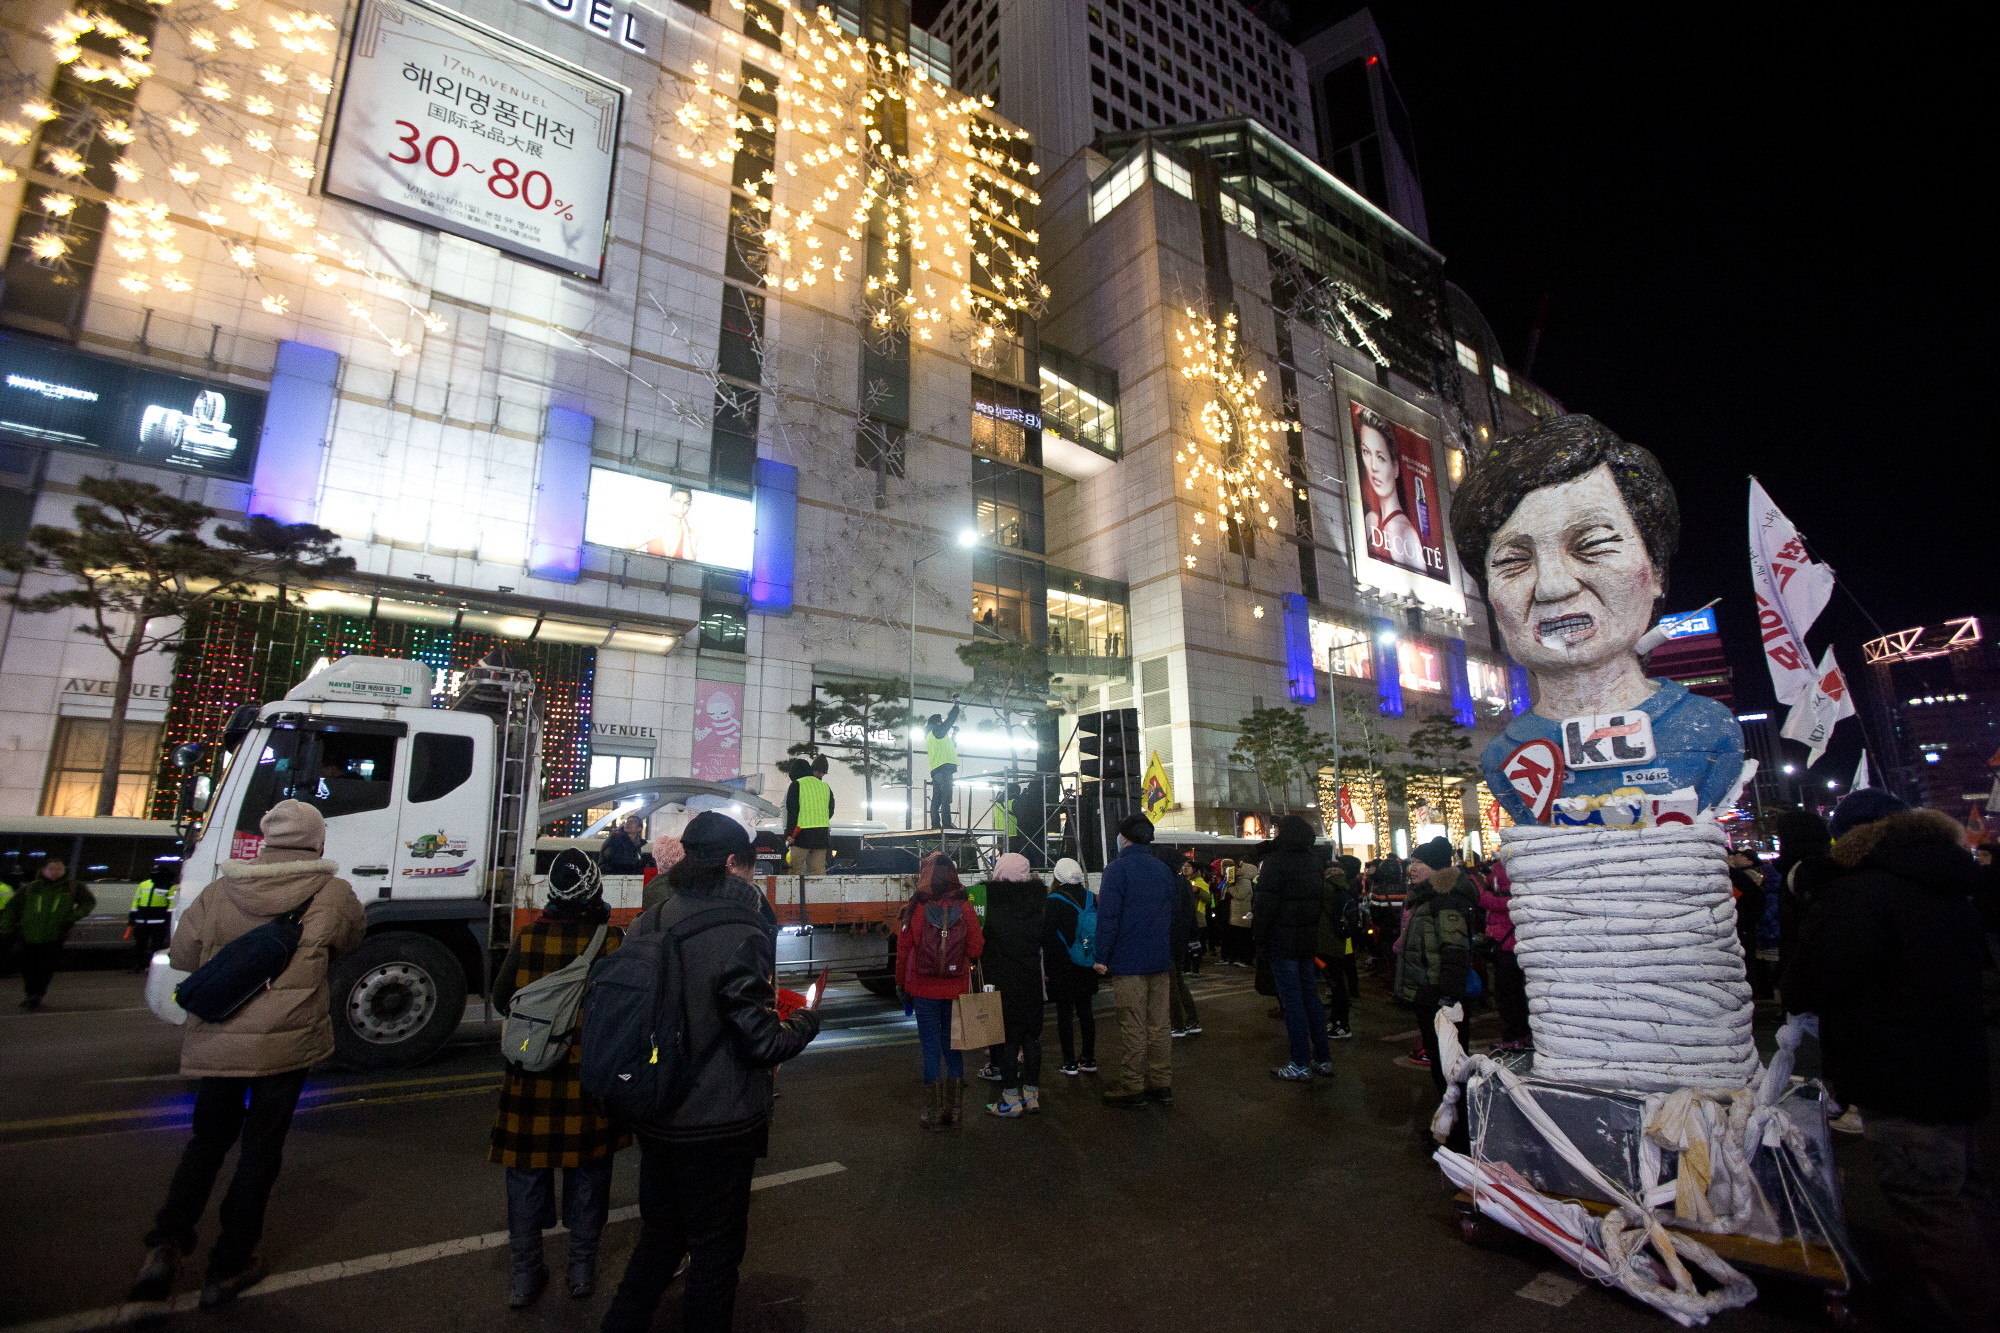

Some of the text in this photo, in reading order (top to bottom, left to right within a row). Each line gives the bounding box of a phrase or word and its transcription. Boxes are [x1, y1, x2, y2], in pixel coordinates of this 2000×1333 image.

[402, 61, 576, 151] 해외명품대전
[441, 54, 548, 109] 17th AVENUEL
[427, 102, 544, 159] 国际名品大展
[1370, 524, 1444, 571] DECORTÉ
[64, 677, 171, 699] AVEUEL
[592, 723, 656, 738] AVENUEL
[1566, 715, 1647, 765] kt
